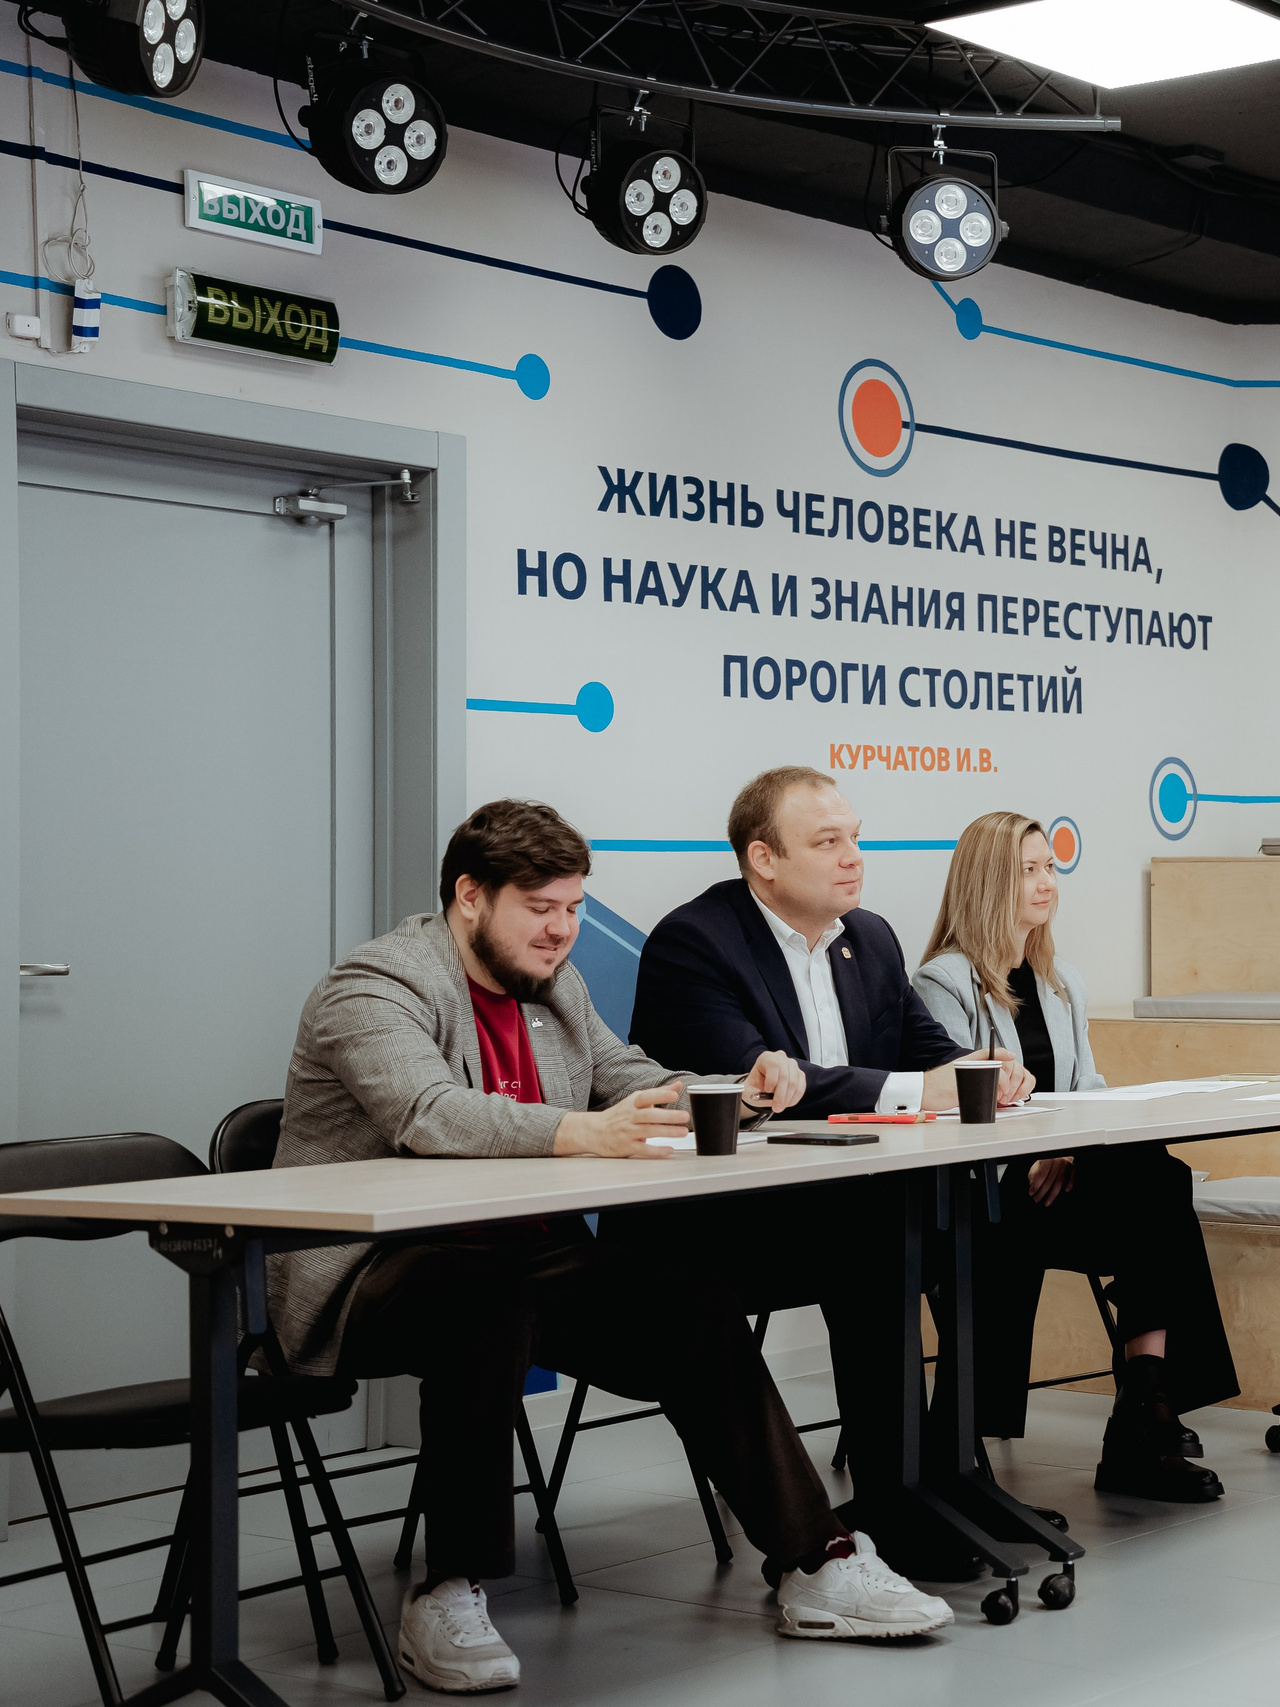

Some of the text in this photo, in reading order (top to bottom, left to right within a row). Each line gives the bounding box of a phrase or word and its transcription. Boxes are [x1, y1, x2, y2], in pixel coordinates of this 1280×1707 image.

[203, 187, 308, 241] ВЫХОД
[206, 286, 329, 353] ВЫХОД
[597, 465, 1163, 585] ЖИЗНЬ ЧЕЛОВЕКА НЕ ВЕЧНА,
[516, 548, 1213, 651] НО НАУКА И ЗНАНИЯ ПЕРЕСТУПАЮТ
[723, 654, 1083, 714] ПОРОГИ СТОЛЕТИЙ
[829, 743, 998, 773] КУРЧАТОВ И.В.
